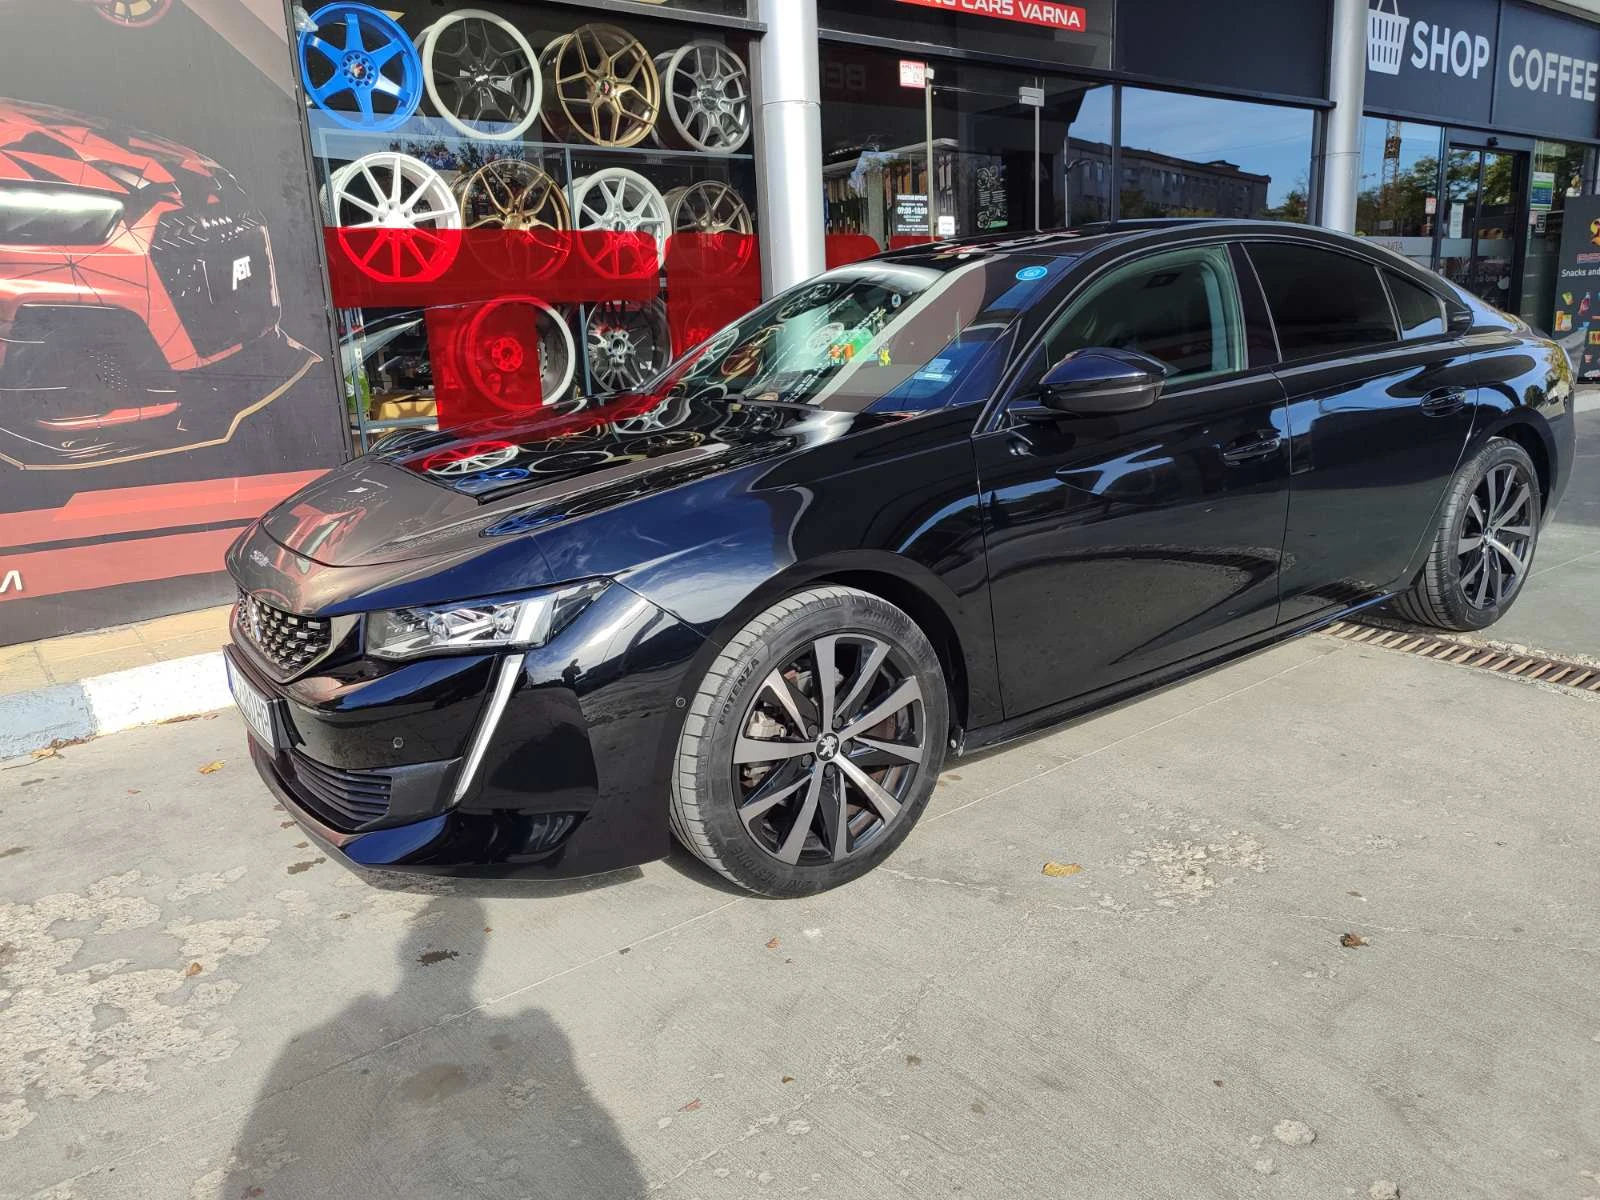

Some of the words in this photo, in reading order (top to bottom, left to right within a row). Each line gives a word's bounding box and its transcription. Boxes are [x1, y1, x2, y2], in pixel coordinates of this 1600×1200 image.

[962, 0, 1014, 16] CARS
[1018, 3, 1080, 28] VARNA
[1411, 20, 1490, 79] SHOP
[1508, 44, 1599, 101] COFFEE
[1561, 268, 1586, 278] Snacks
